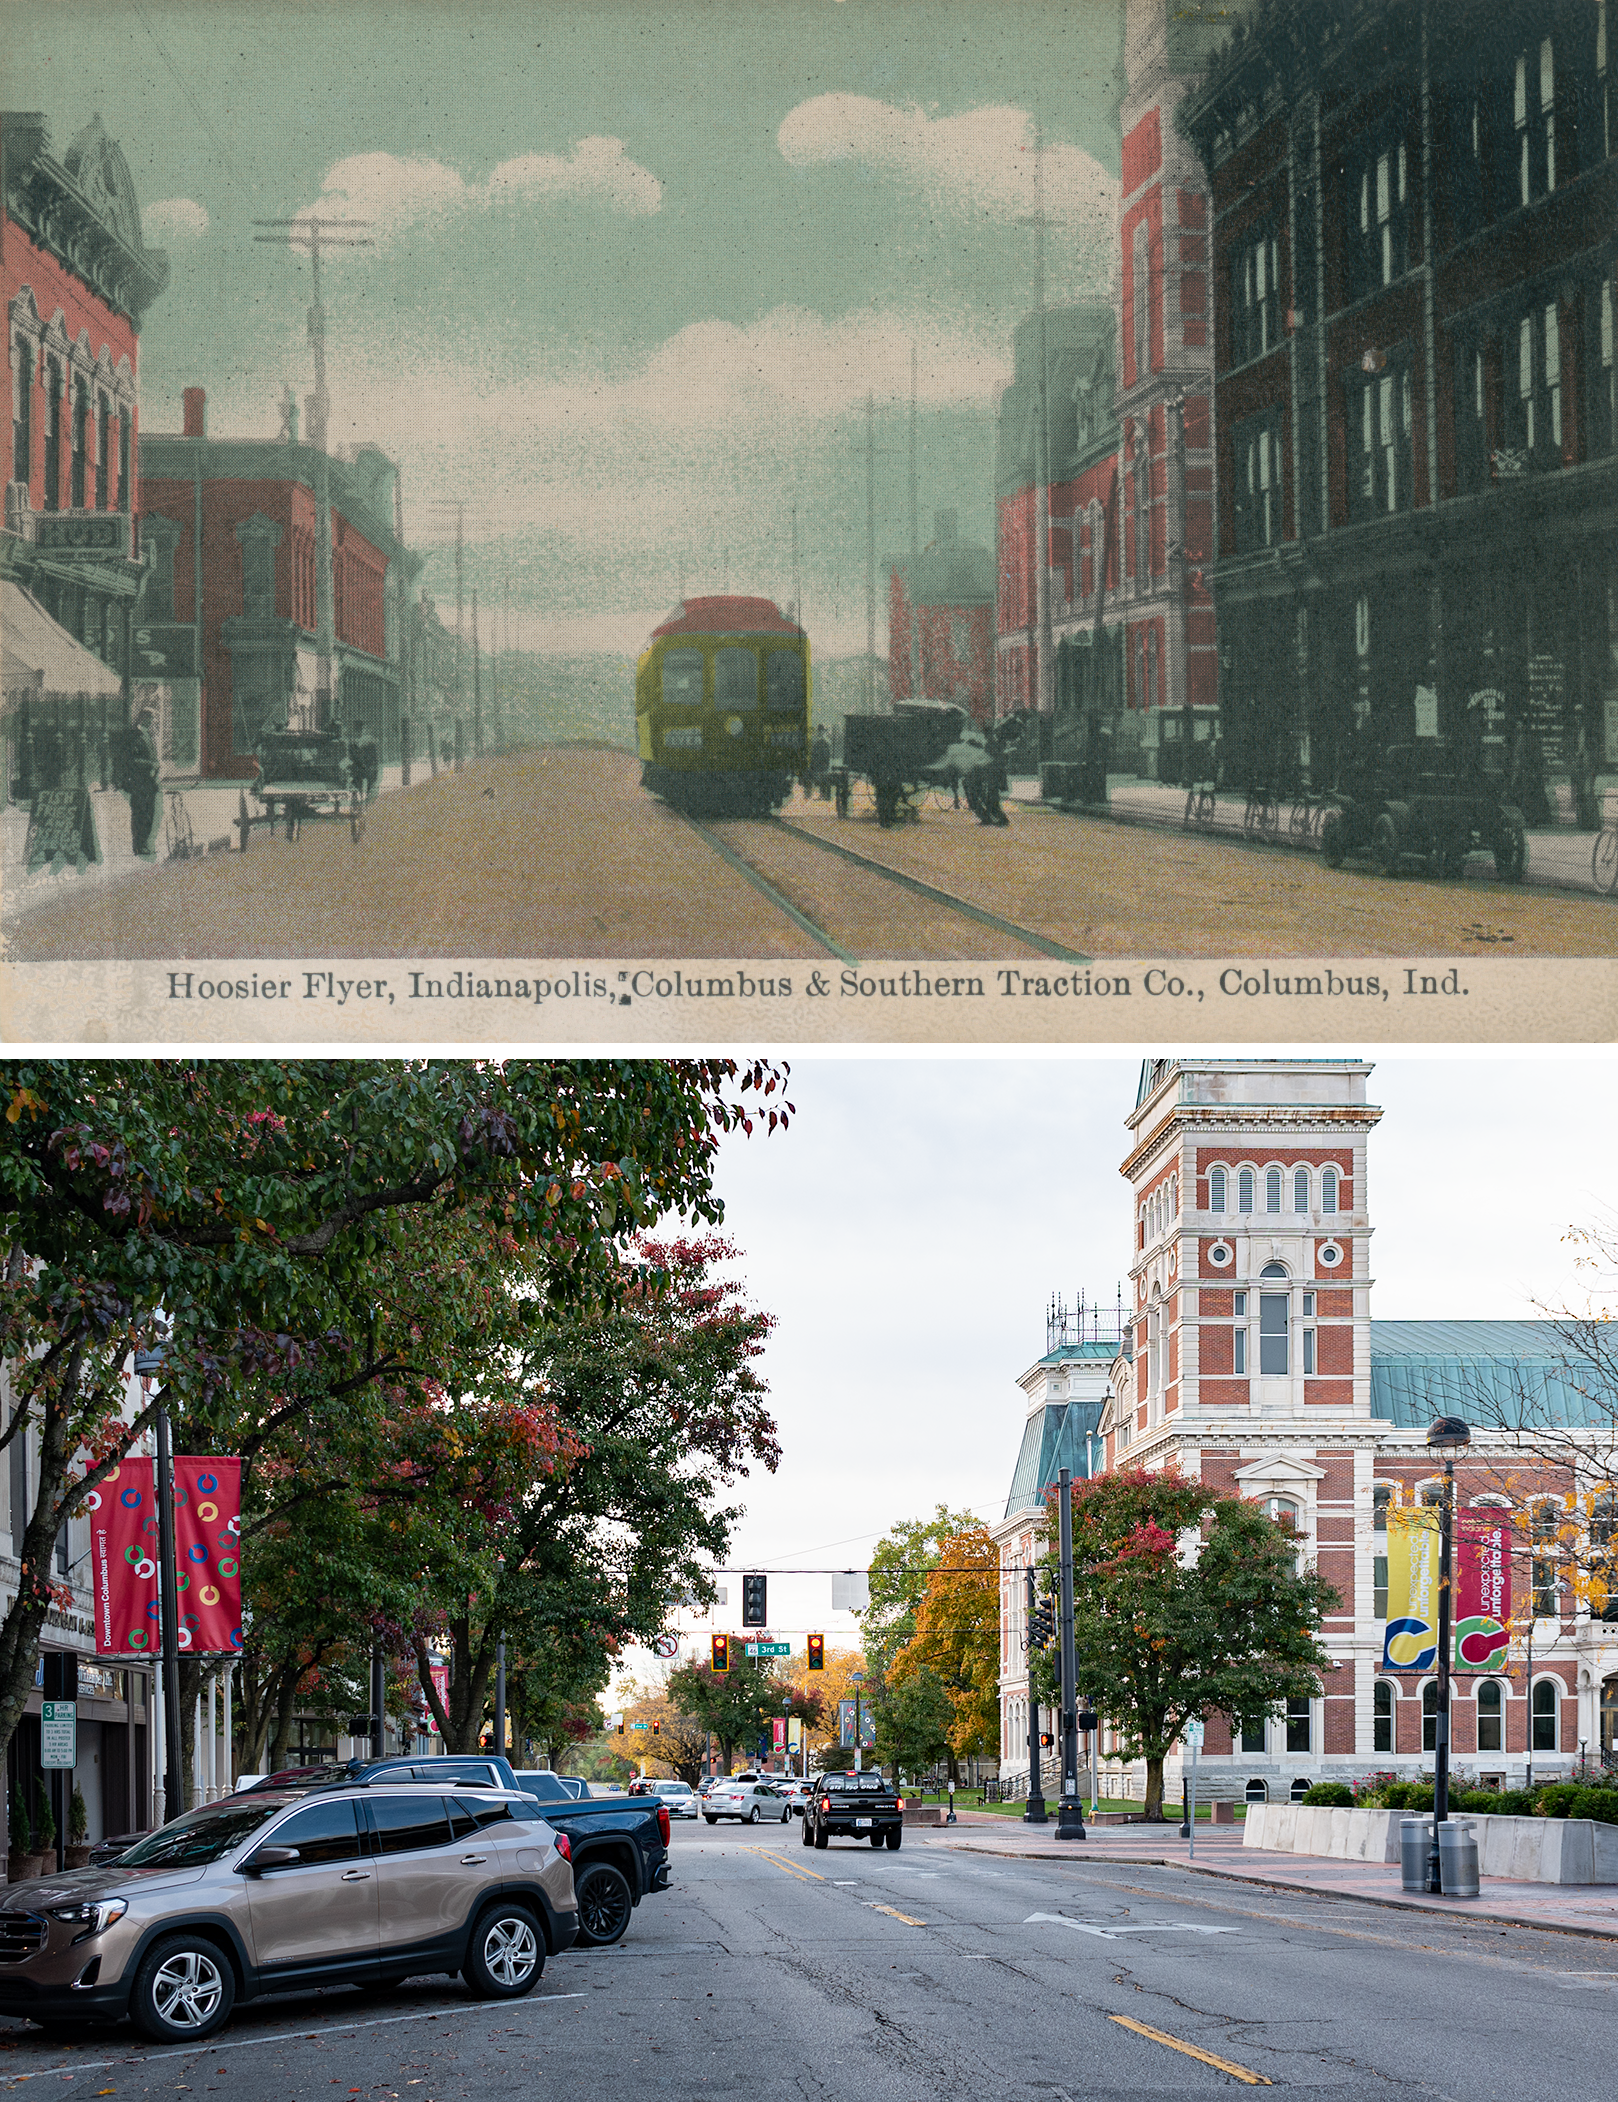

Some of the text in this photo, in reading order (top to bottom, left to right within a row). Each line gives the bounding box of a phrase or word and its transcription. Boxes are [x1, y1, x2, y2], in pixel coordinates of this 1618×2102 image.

[34, 803, 78, 821] FRIES
[36, 790, 74, 805] FISH
[100, 1559, 110, 1602] Columbus
[1408, 1533, 1420, 1612] unexpected.
[1479, 1533, 1491, 1611] unexpected.
[1490, 1527, 1505, 1617] unforgettable.
[103, 1602, 112, 1647] Downtown
[778, 1645, 788, 1653] St
[45, 1705, 53, 1718] 3
